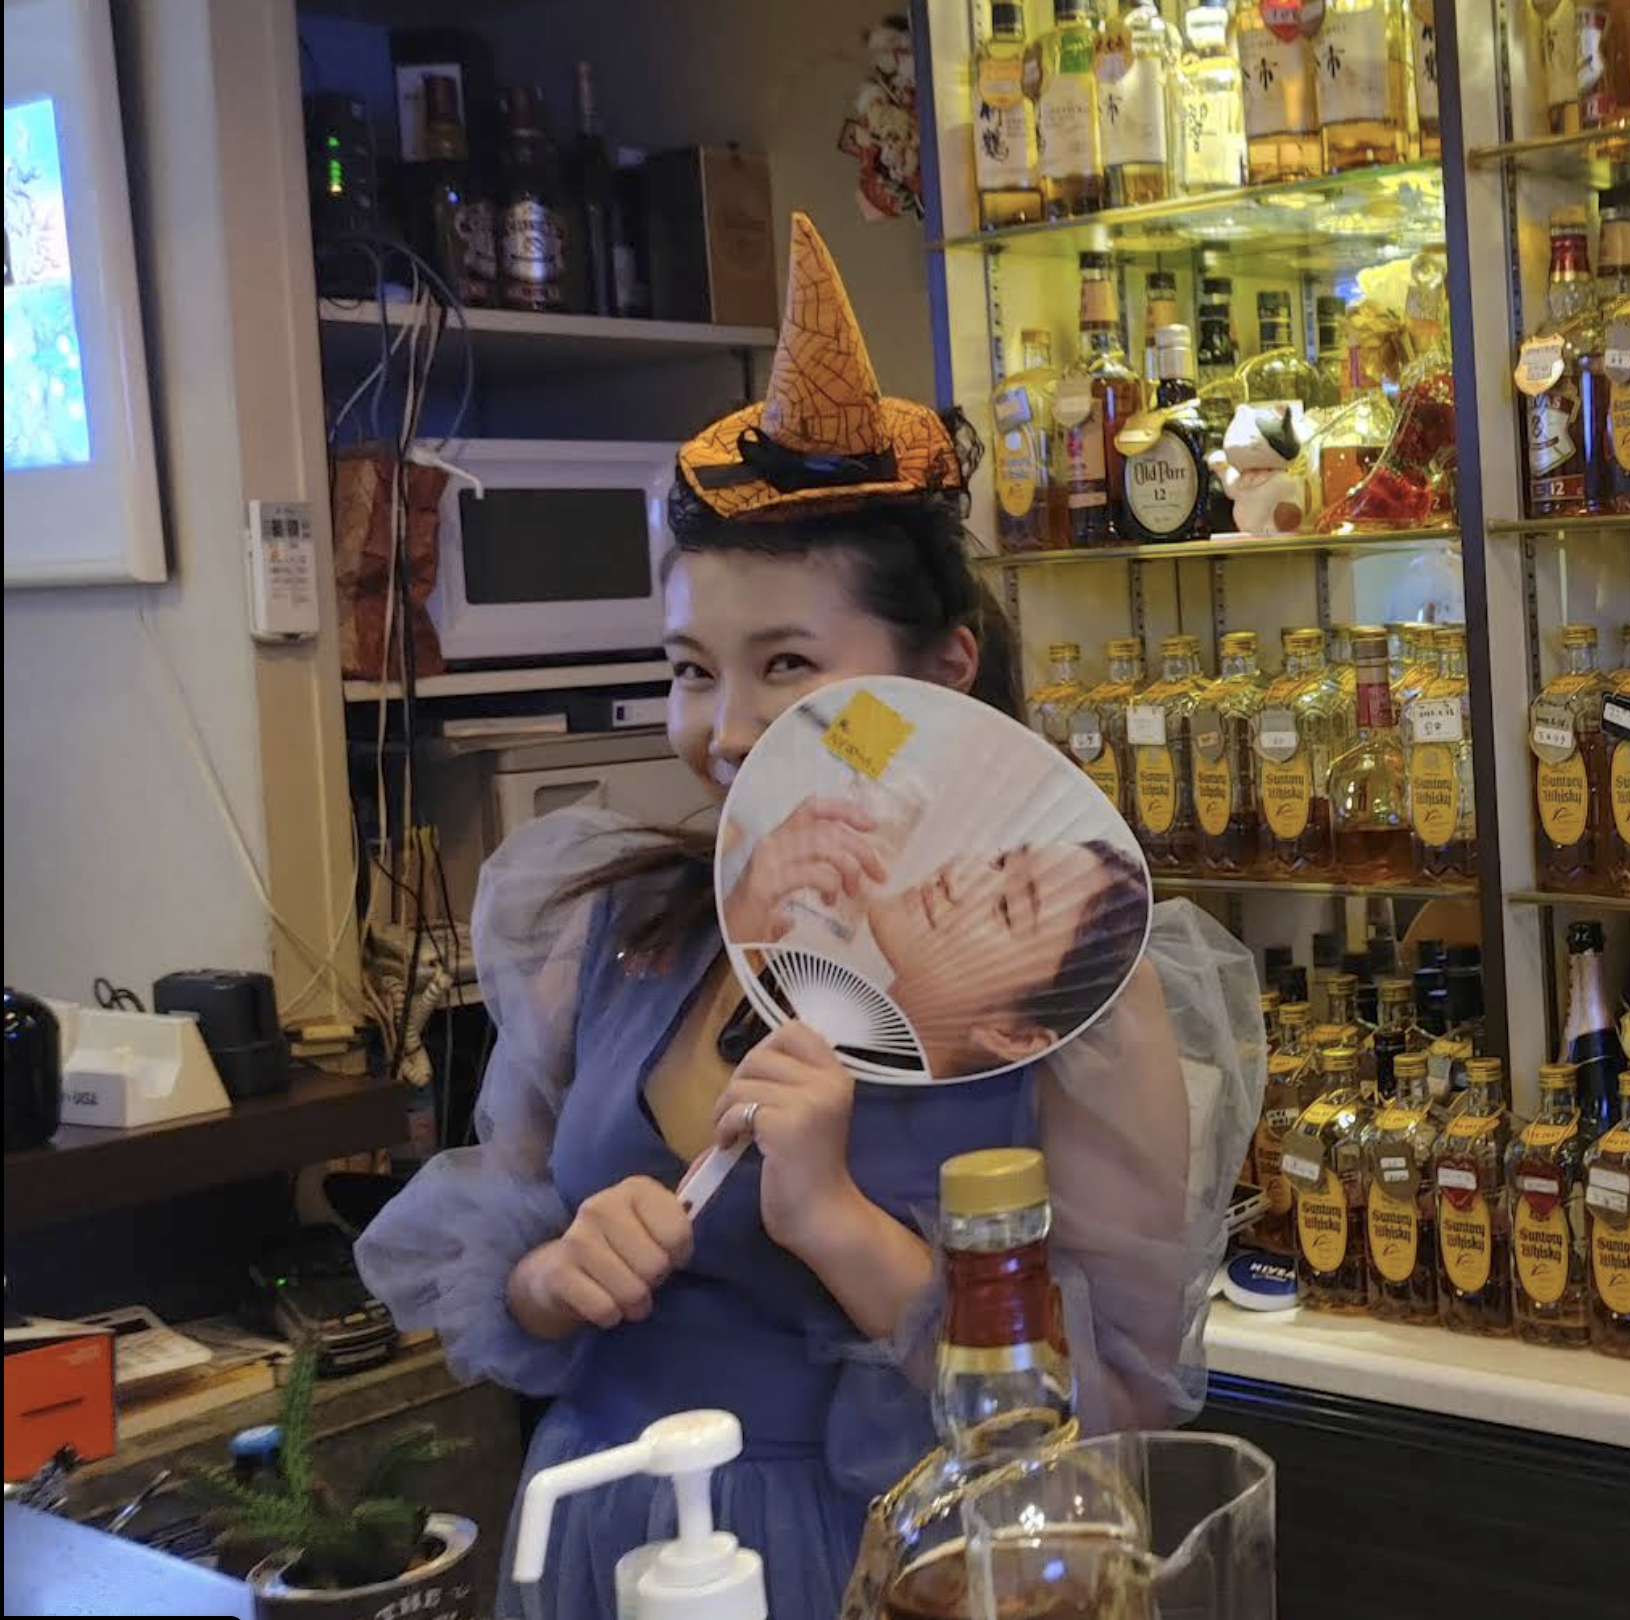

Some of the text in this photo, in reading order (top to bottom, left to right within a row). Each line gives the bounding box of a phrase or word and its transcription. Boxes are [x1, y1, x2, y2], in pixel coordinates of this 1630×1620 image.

[1134, 460, 1186, 485] Old Parr
[1155, 488, 1166, 500] 12
[1550, 482, 1565, 496] 12
[1542, 774, 1583, 790] Suntory
[1542, 789, 1582, 805] Whisky
[1302, 1202, 1342, 1218] Suntory
[1372, 1209, 1412, 1228] Suntory
[1305, 1216, 1341, 1235] Whisky
[1374, 1224, 1411, 1243] Whisky
[1443, 1218, 1485, 1237] Suntory
[1446, 1234, 1485, 1251] Whisky
[1519, 1227, 1562, 1248] Suntory
[1521, 1243, 1562, 1264] Whisky
[1250, 1262, 1296, 1281] NIVEA
